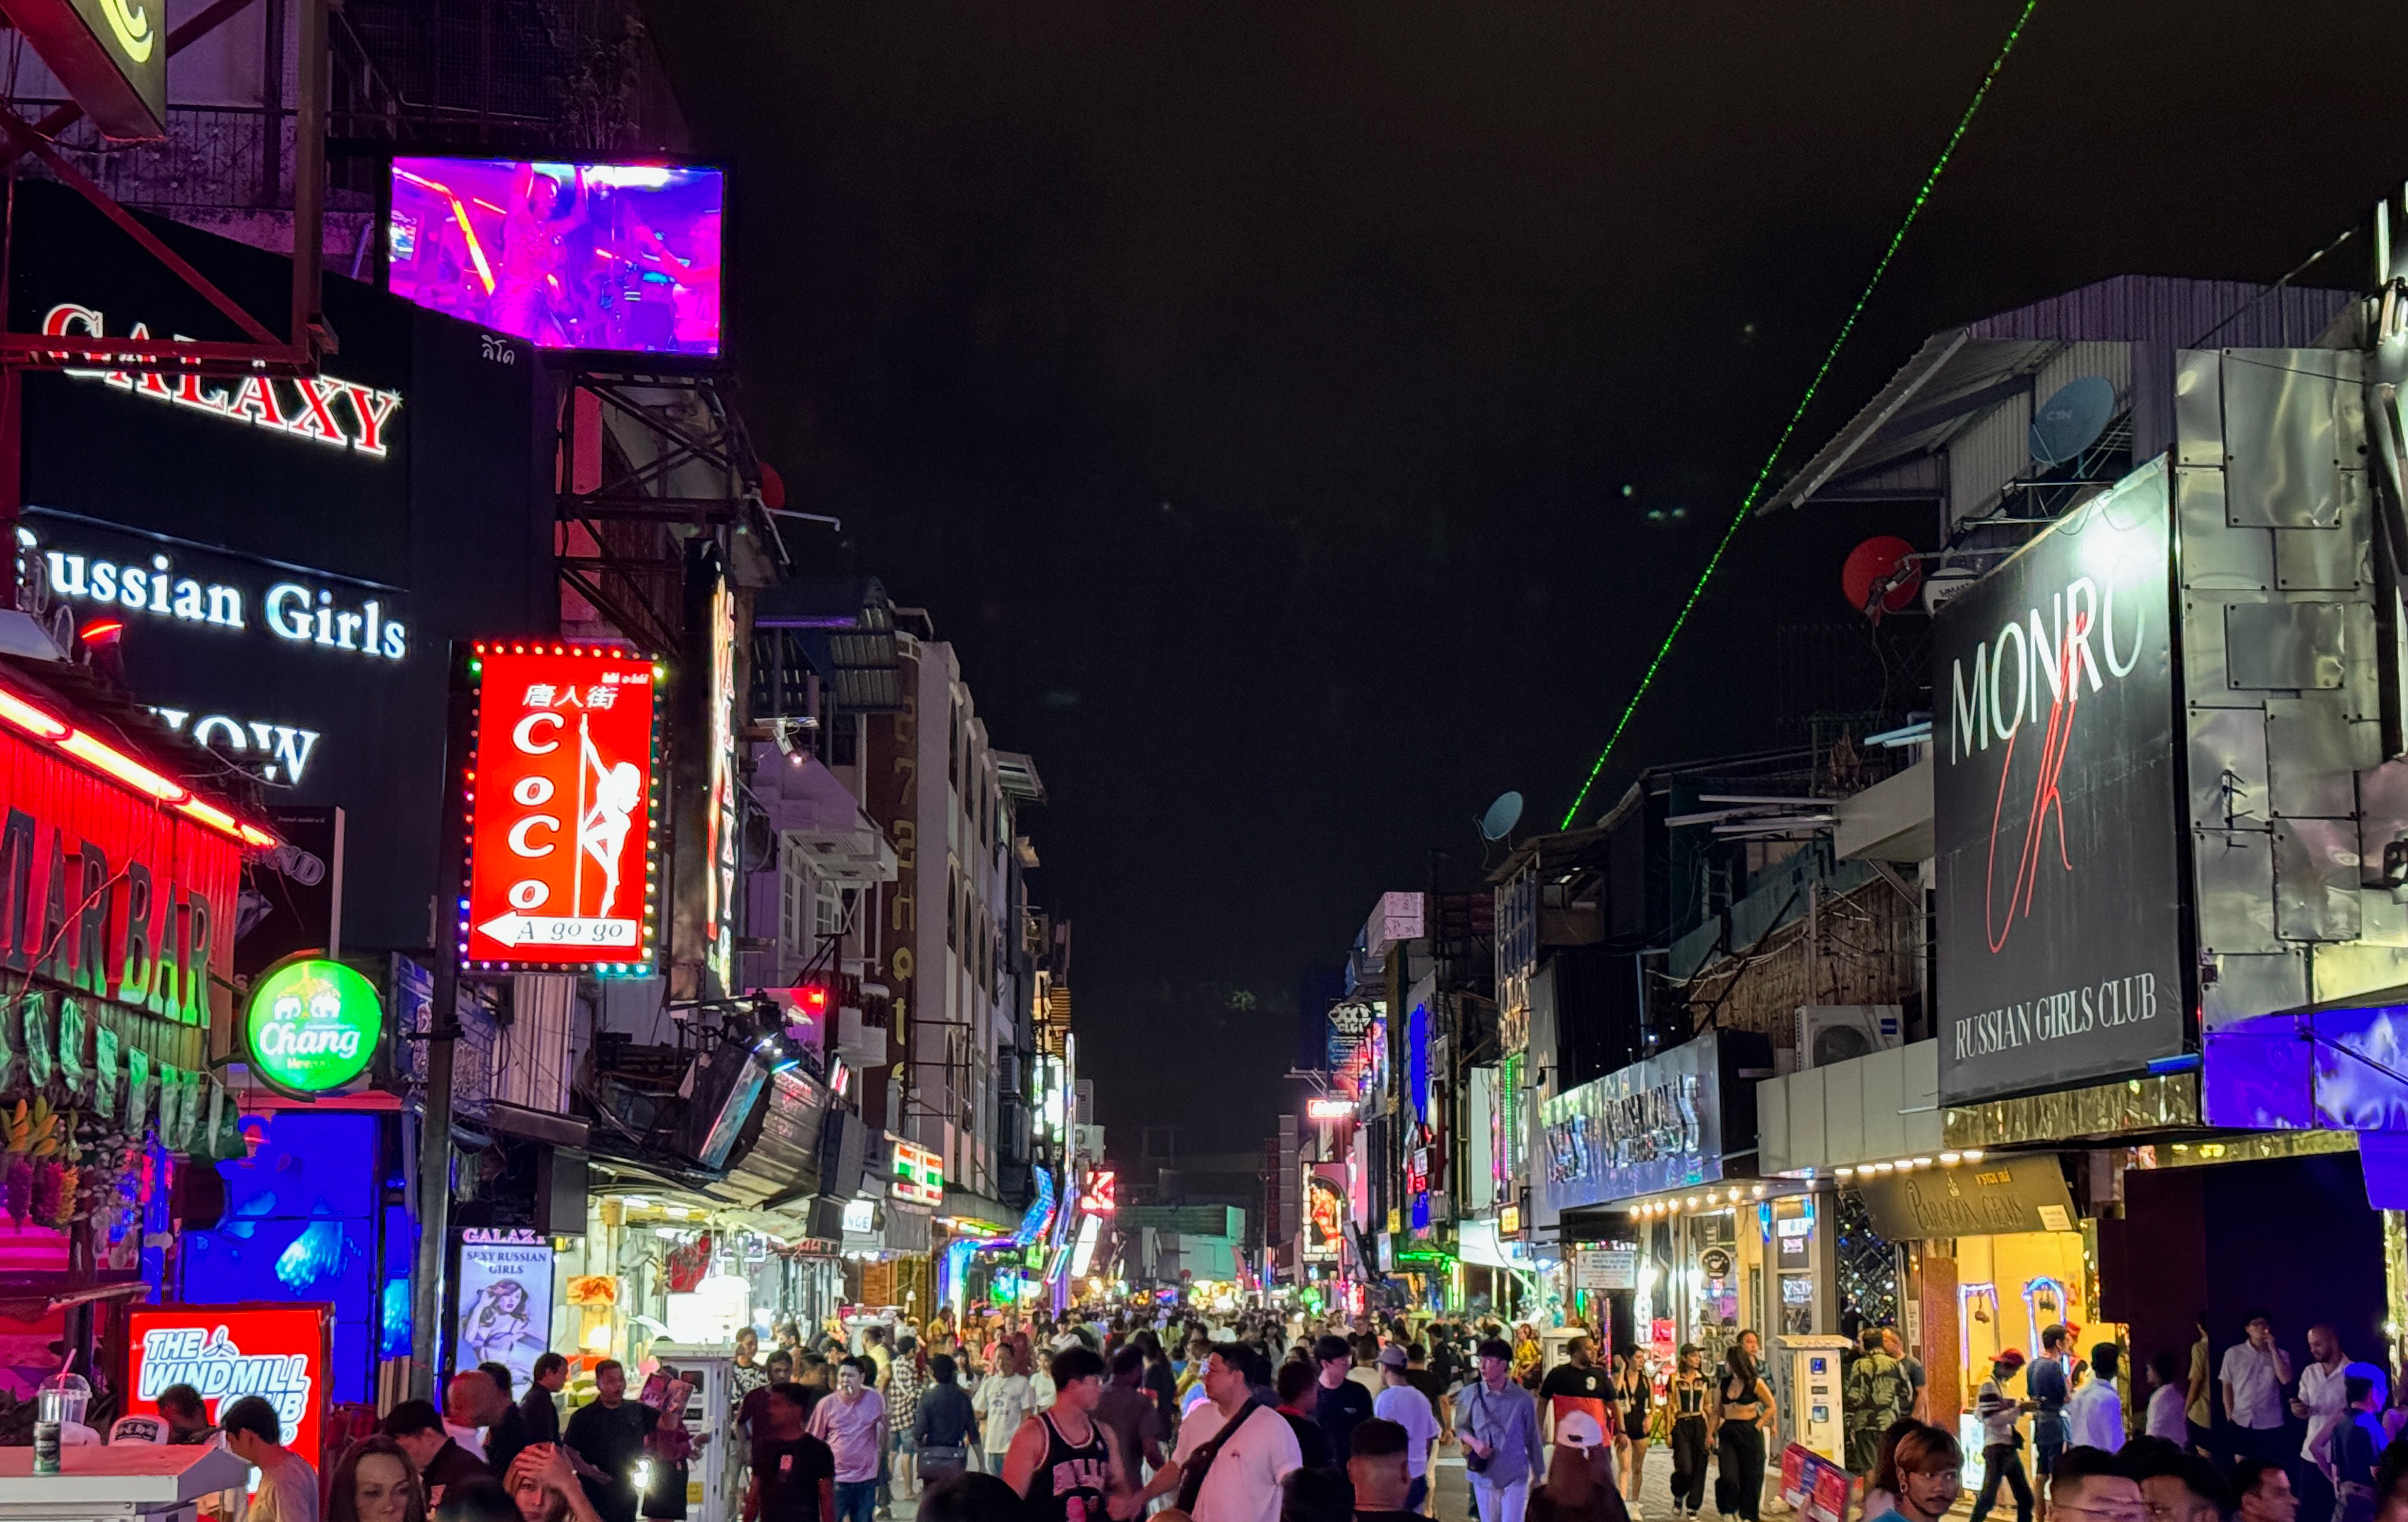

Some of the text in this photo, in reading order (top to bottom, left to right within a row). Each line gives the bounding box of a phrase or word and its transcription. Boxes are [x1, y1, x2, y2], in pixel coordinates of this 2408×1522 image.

[16, 527, 407, 659] ussian Girls
[523, 684, 618, 710] 唐人街
[119, 858, 213, 1031] BAR
[518, 918, 624, 942] A go go
[1955, 972, 2157, 1060] RUSSIAN GIRLS CLUB
[259, 1022, 361, 1057] Chang
[1905, 1179, 1982, 1230] PARAGON
[466, 1252, 548, 1262] SEXY RUSSIAN
[489, 1264, 524, 1275] GIRLS
[147, 1331, 204, 1361] THE
[142, 1358, 308, 1397] WINDMILL
